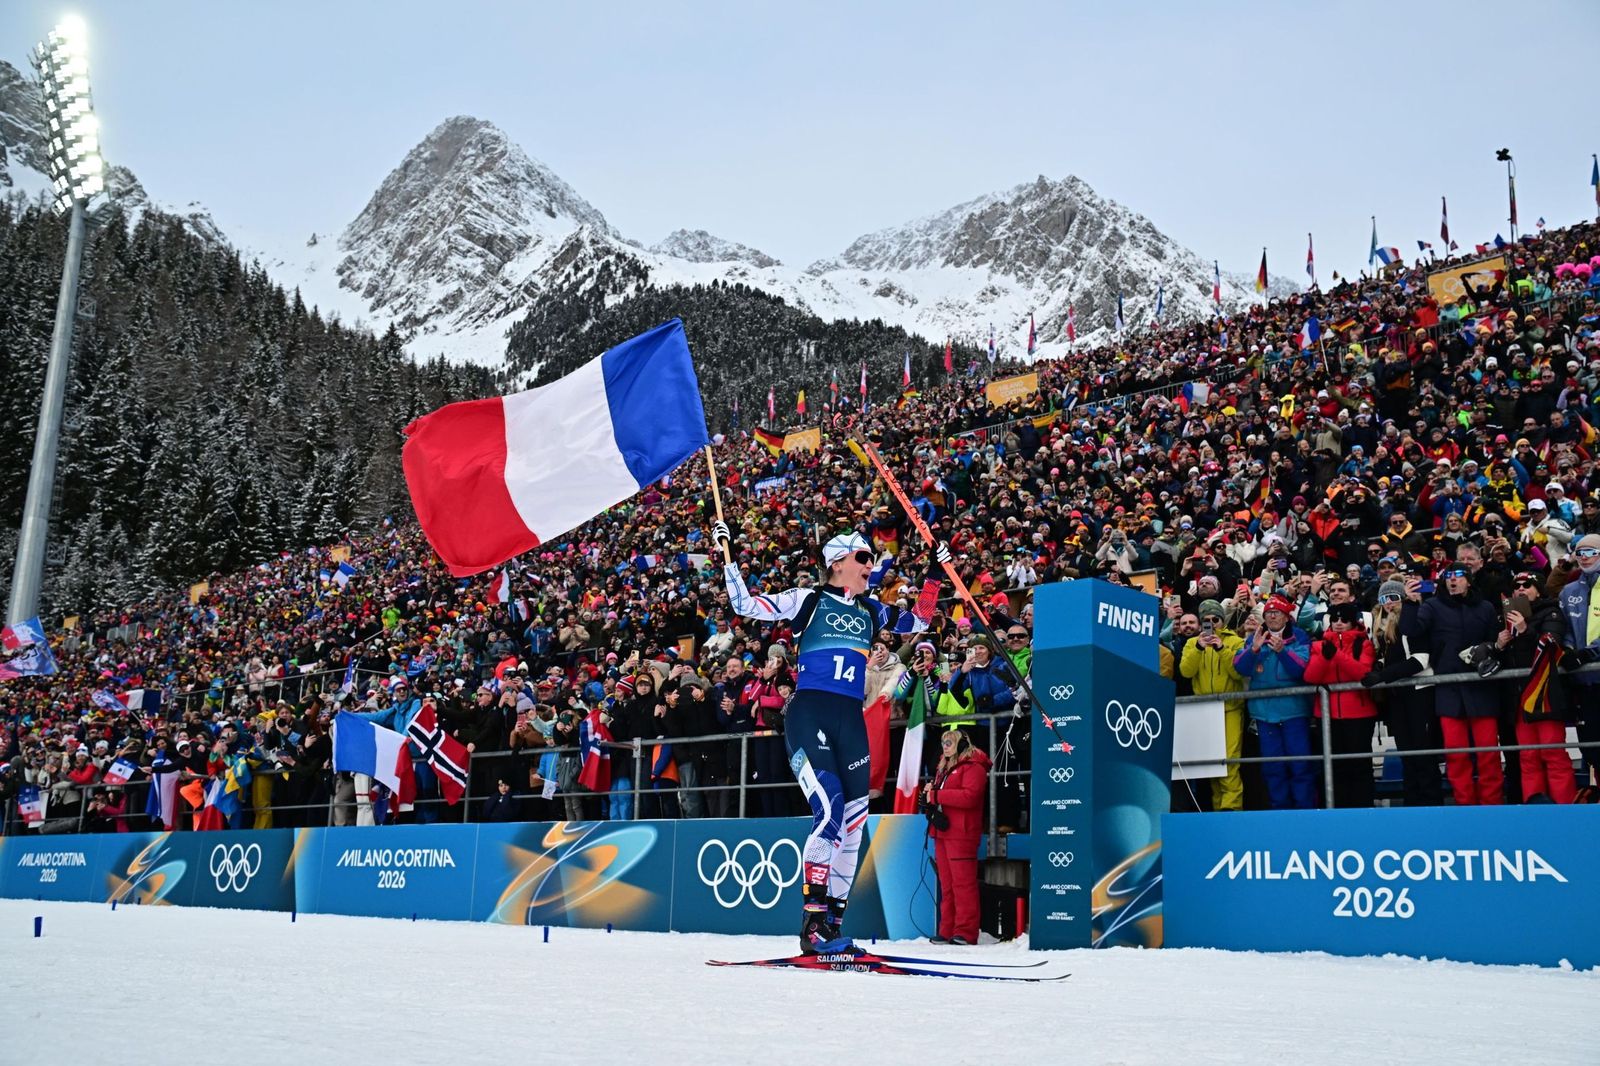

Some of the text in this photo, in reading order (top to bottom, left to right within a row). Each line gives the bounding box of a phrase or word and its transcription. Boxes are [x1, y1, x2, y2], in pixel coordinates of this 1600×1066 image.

[1097, 601, 1155, 637] FINISH
[17, 852, 87, 867] MILANO CORTINA
[336, 849, 456, 868] MILANO CORTINA
[1205, 849, 1569, 883] MILANO CORTINA
[40, 868, 58, 882] 2026
[377, 870, 406, 889] 2026
[1333, 886, 1415, 919] 2026
[816, 954, 855, 963] SALOMON
[830, 963, 870, 973] SALOMON
